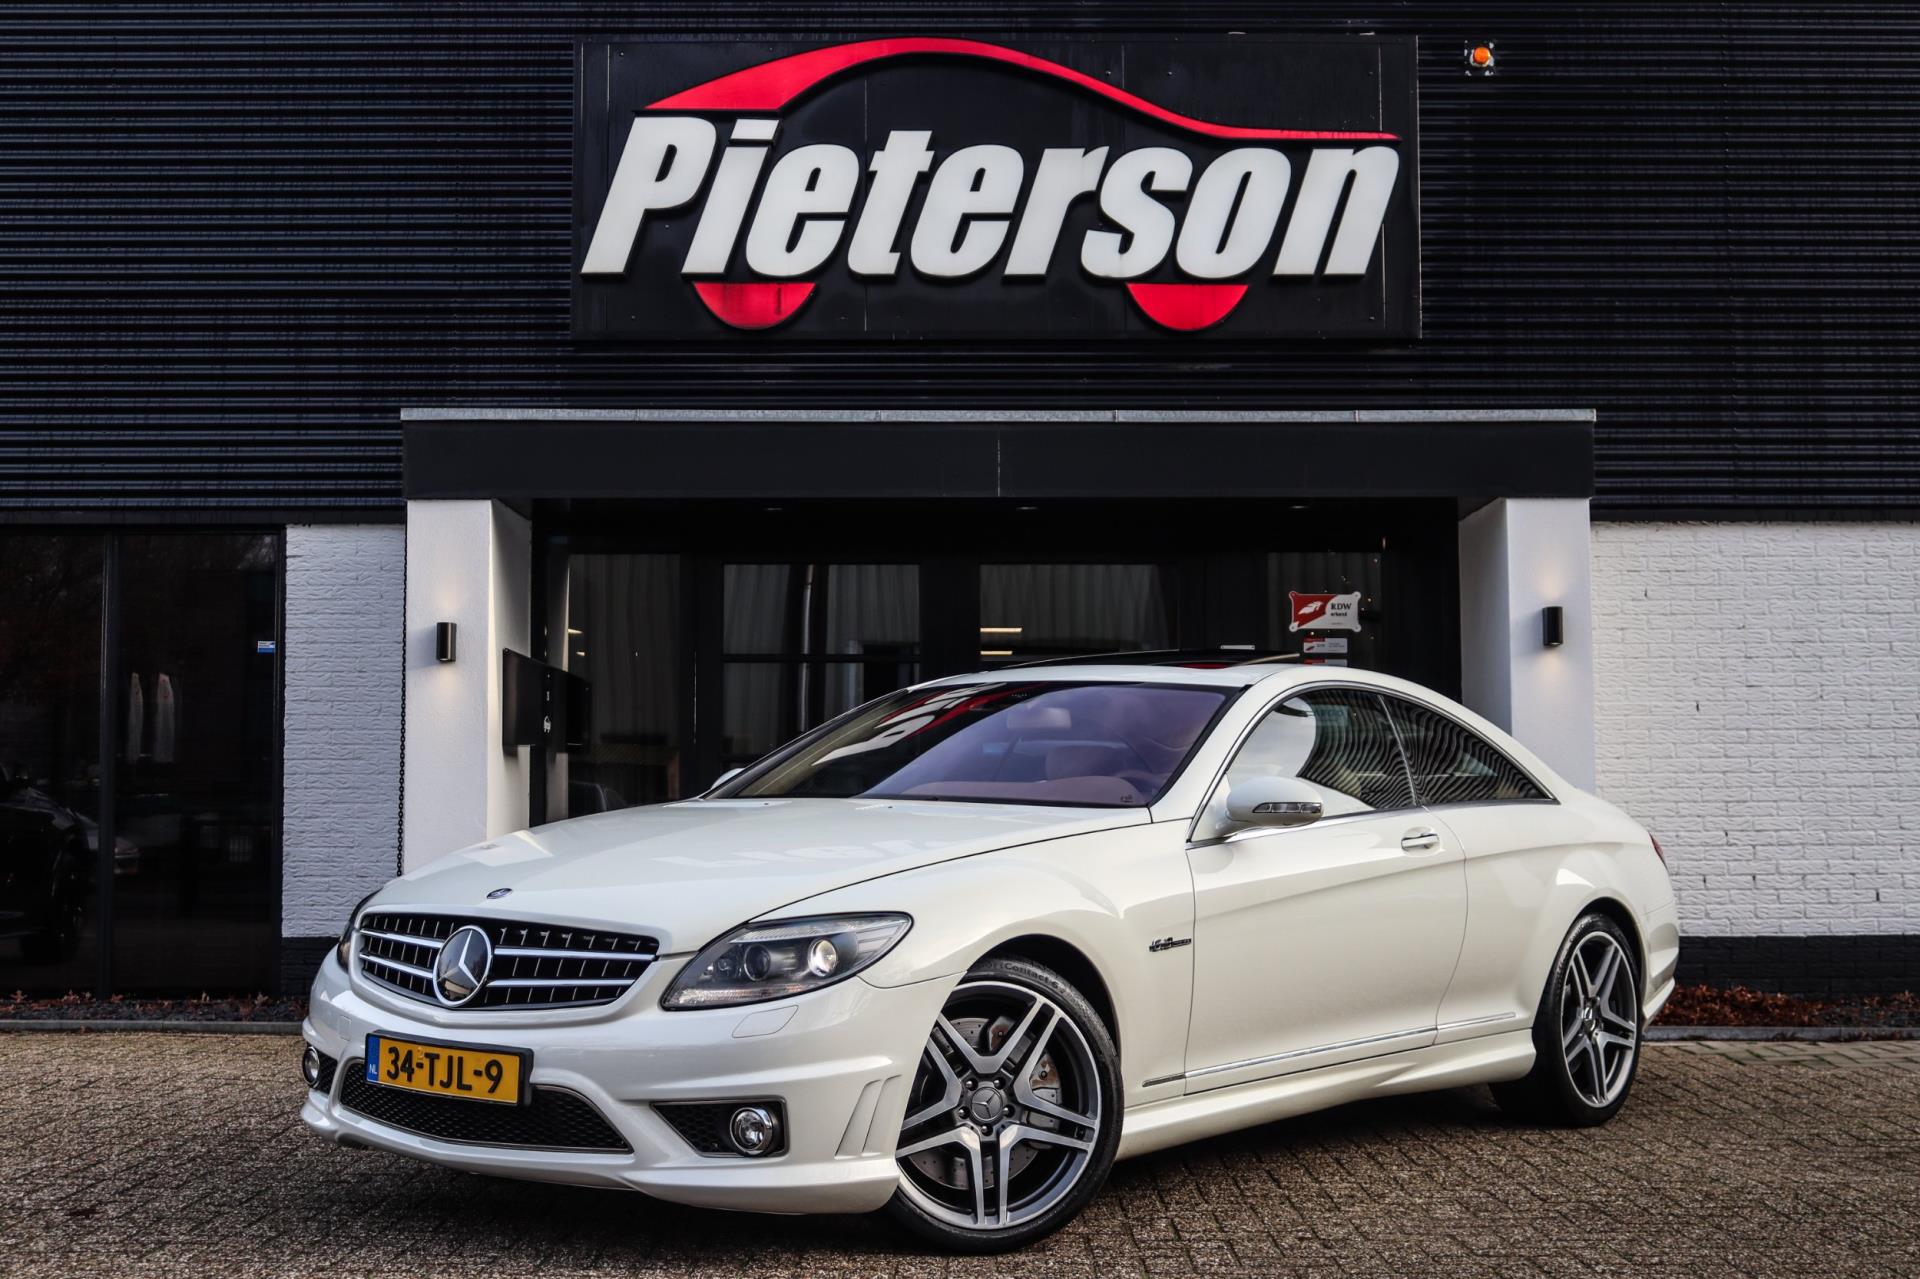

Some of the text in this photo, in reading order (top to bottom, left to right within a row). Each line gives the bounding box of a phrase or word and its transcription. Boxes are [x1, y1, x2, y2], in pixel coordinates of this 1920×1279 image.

[579, 115, 1400, 280] Pieterson
[368, 1063, 378, 1075] NL
[386, 1046, 503, 1094] 34-TJL-9
